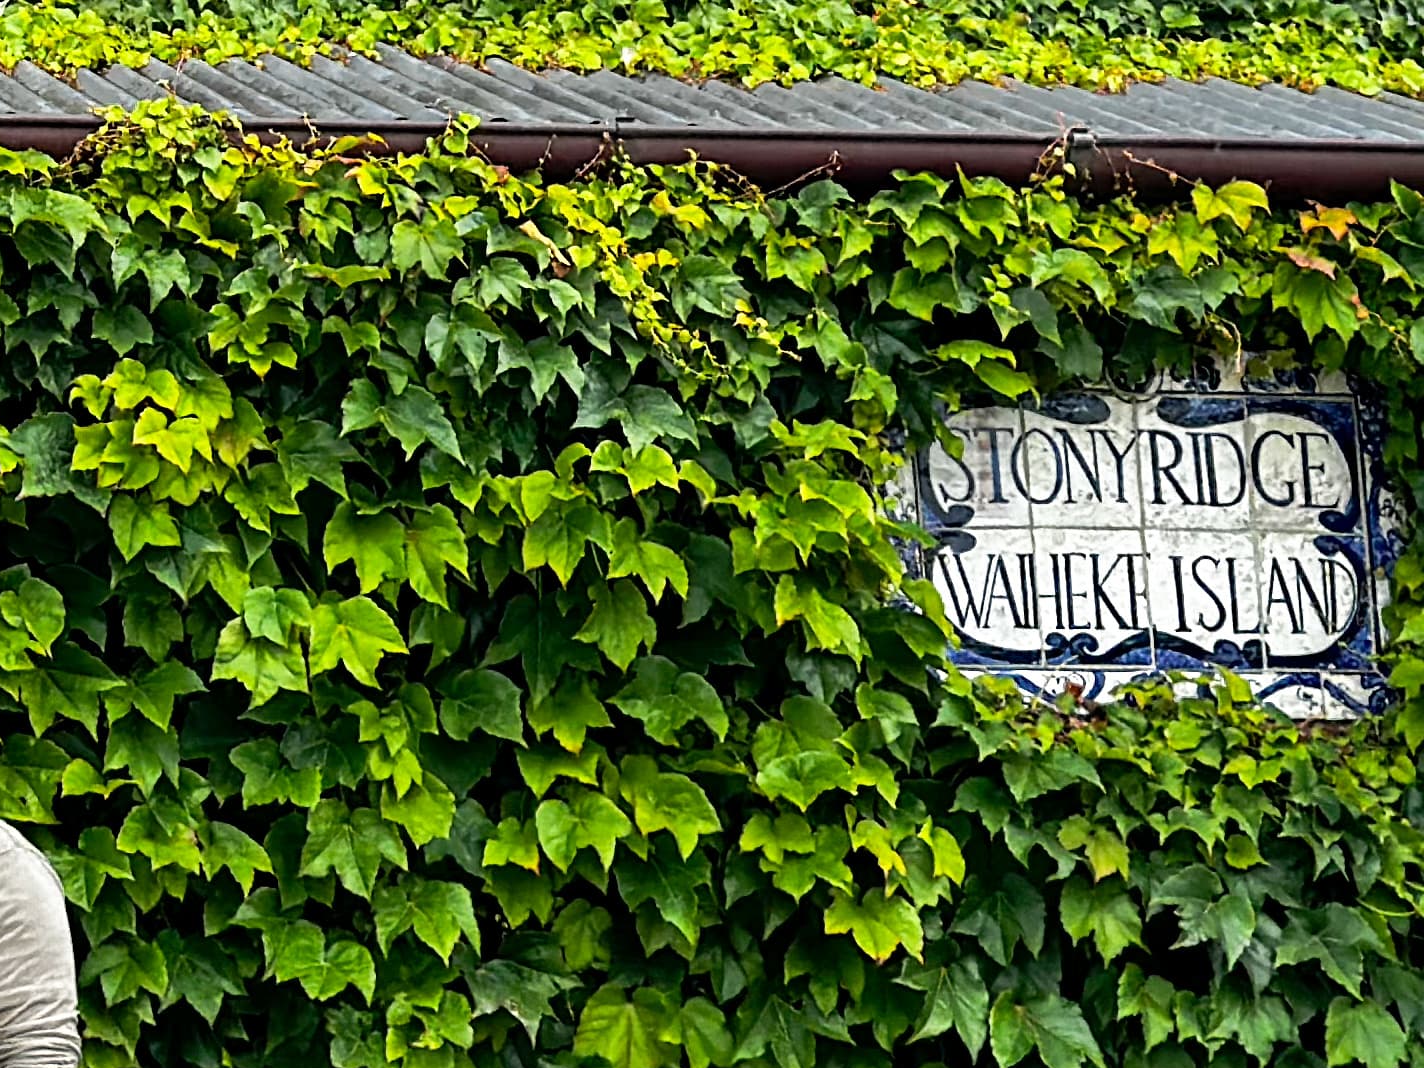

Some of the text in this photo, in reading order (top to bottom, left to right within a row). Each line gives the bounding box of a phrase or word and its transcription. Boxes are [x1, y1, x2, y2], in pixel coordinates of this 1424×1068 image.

[939, 427, 1341, 509] STONYRIDGE
[937, 552, 1357, 636] WAIHEKE ISLAND
